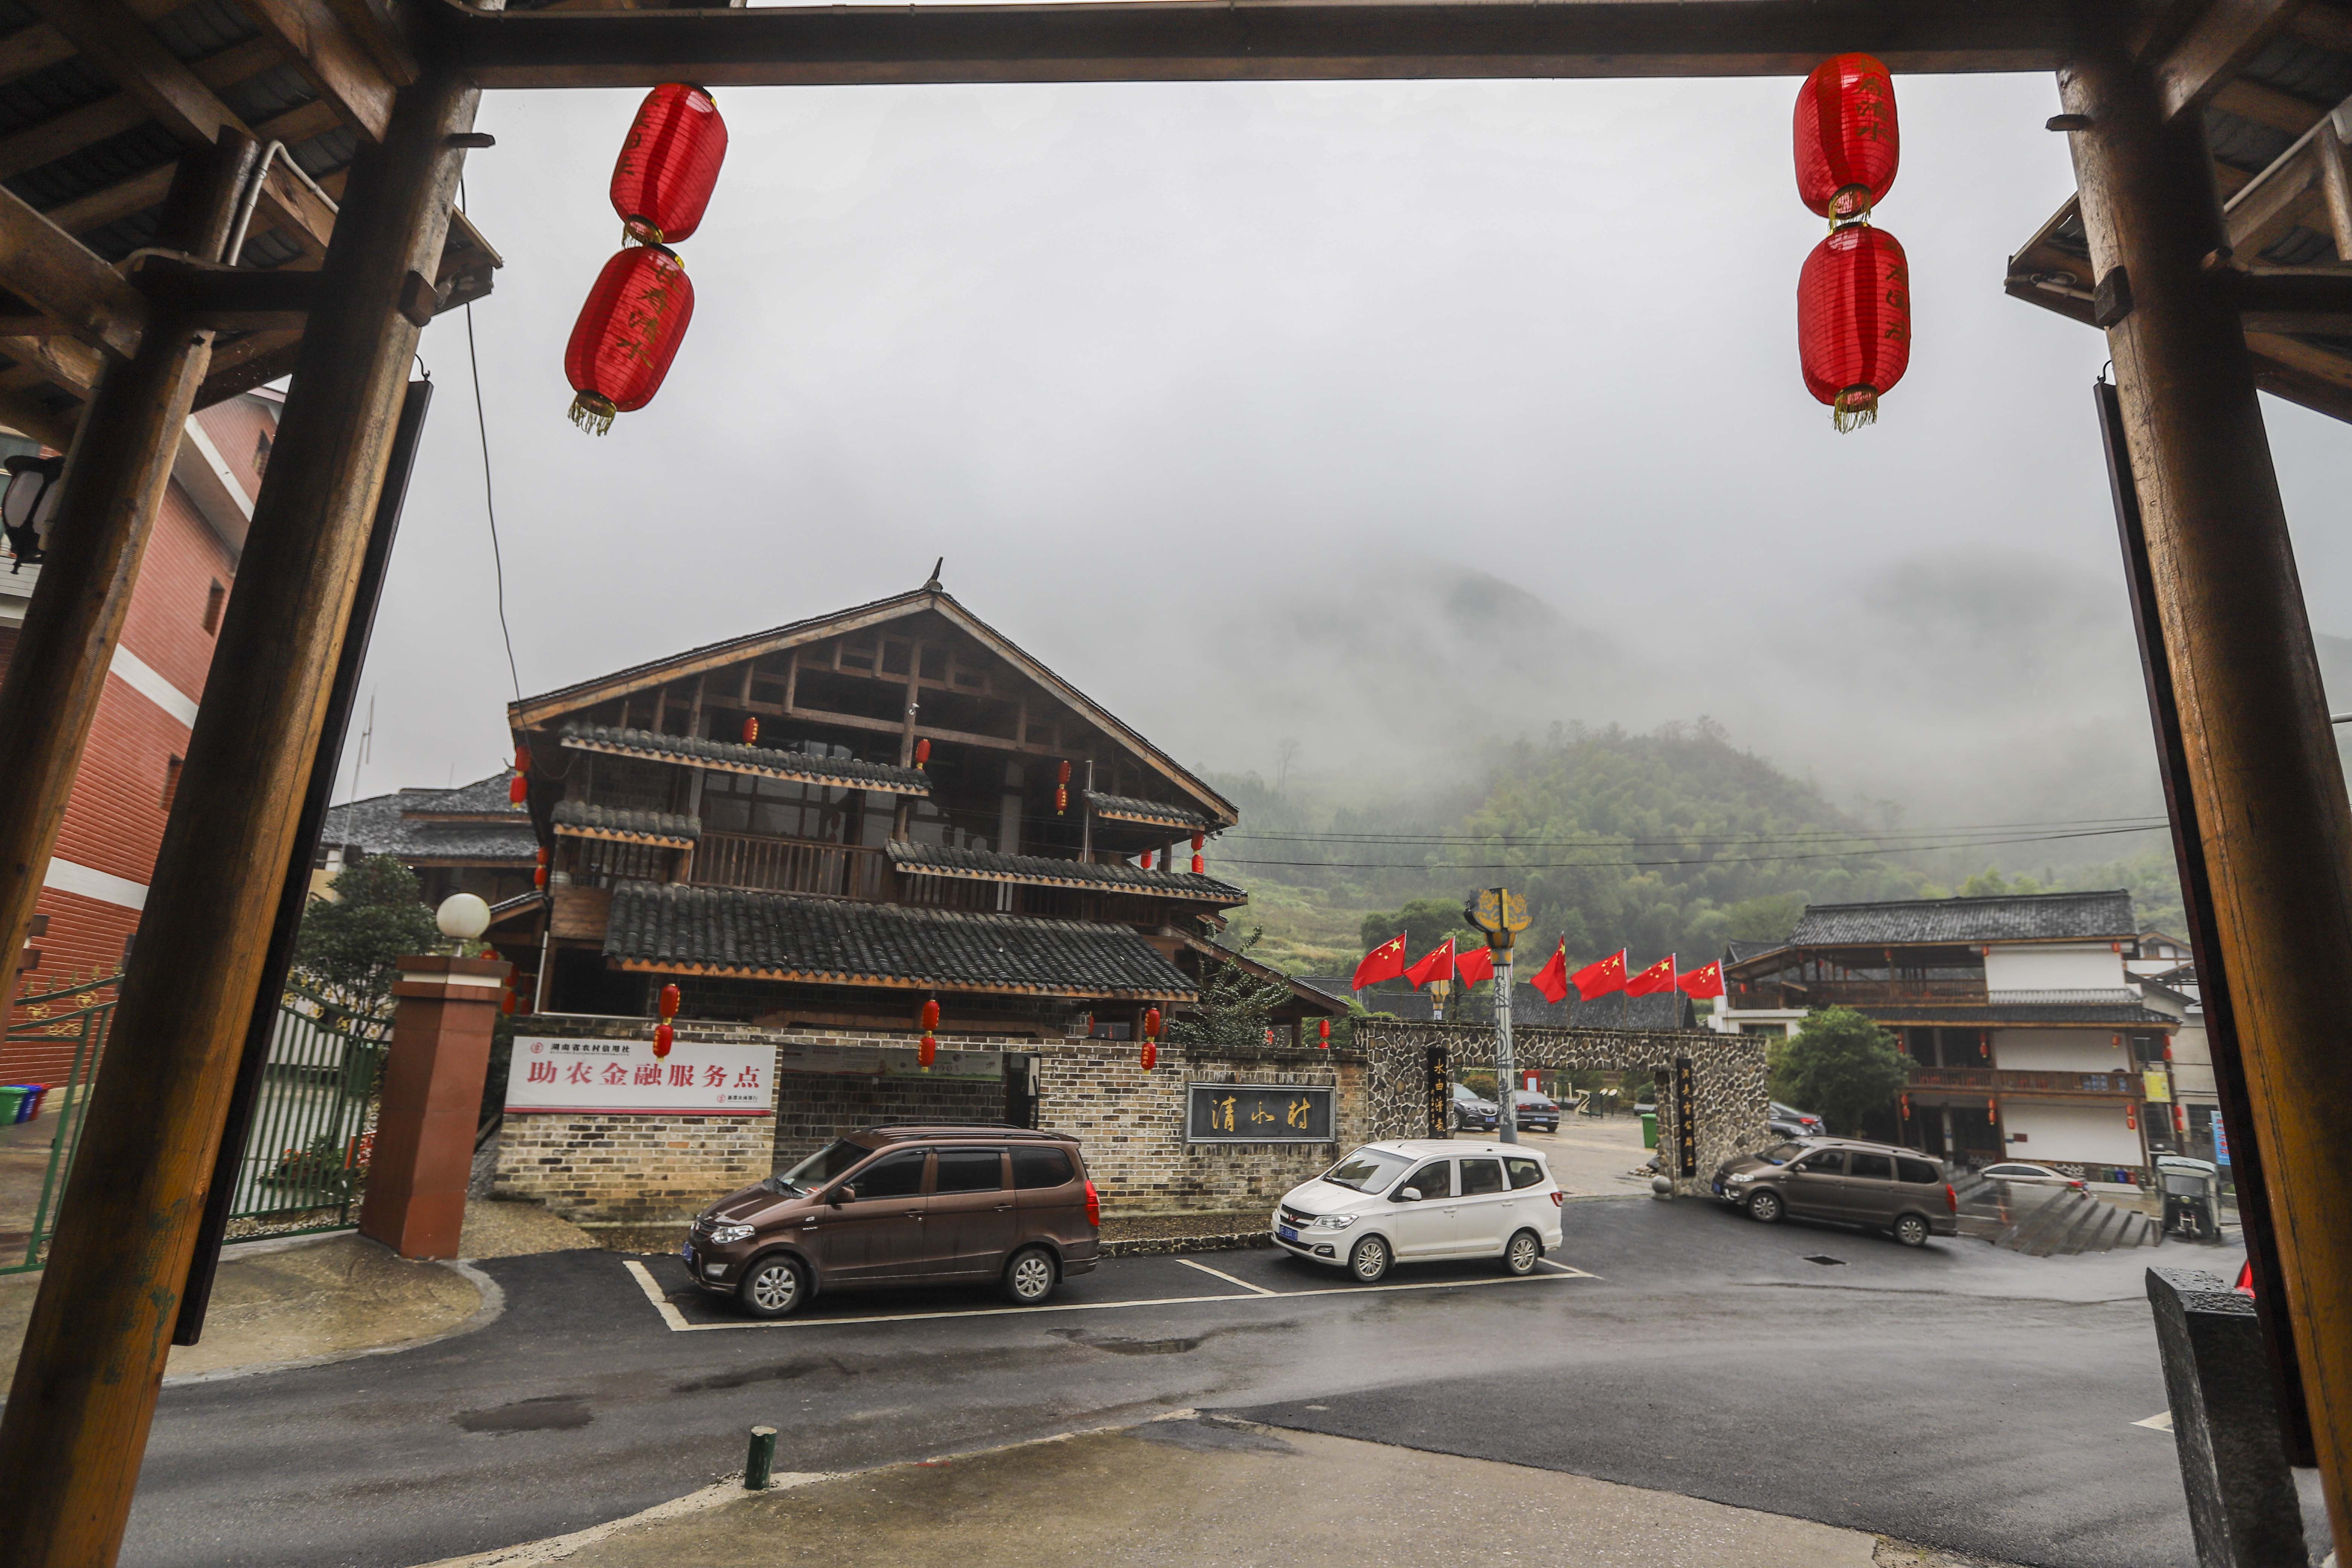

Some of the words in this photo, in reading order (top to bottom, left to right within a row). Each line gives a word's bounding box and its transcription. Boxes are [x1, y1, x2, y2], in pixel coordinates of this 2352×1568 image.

[550, 1043, 631, 1053] 湖南省农村信用社
[527, 1061, 760, 1088] 助农金融服务点
